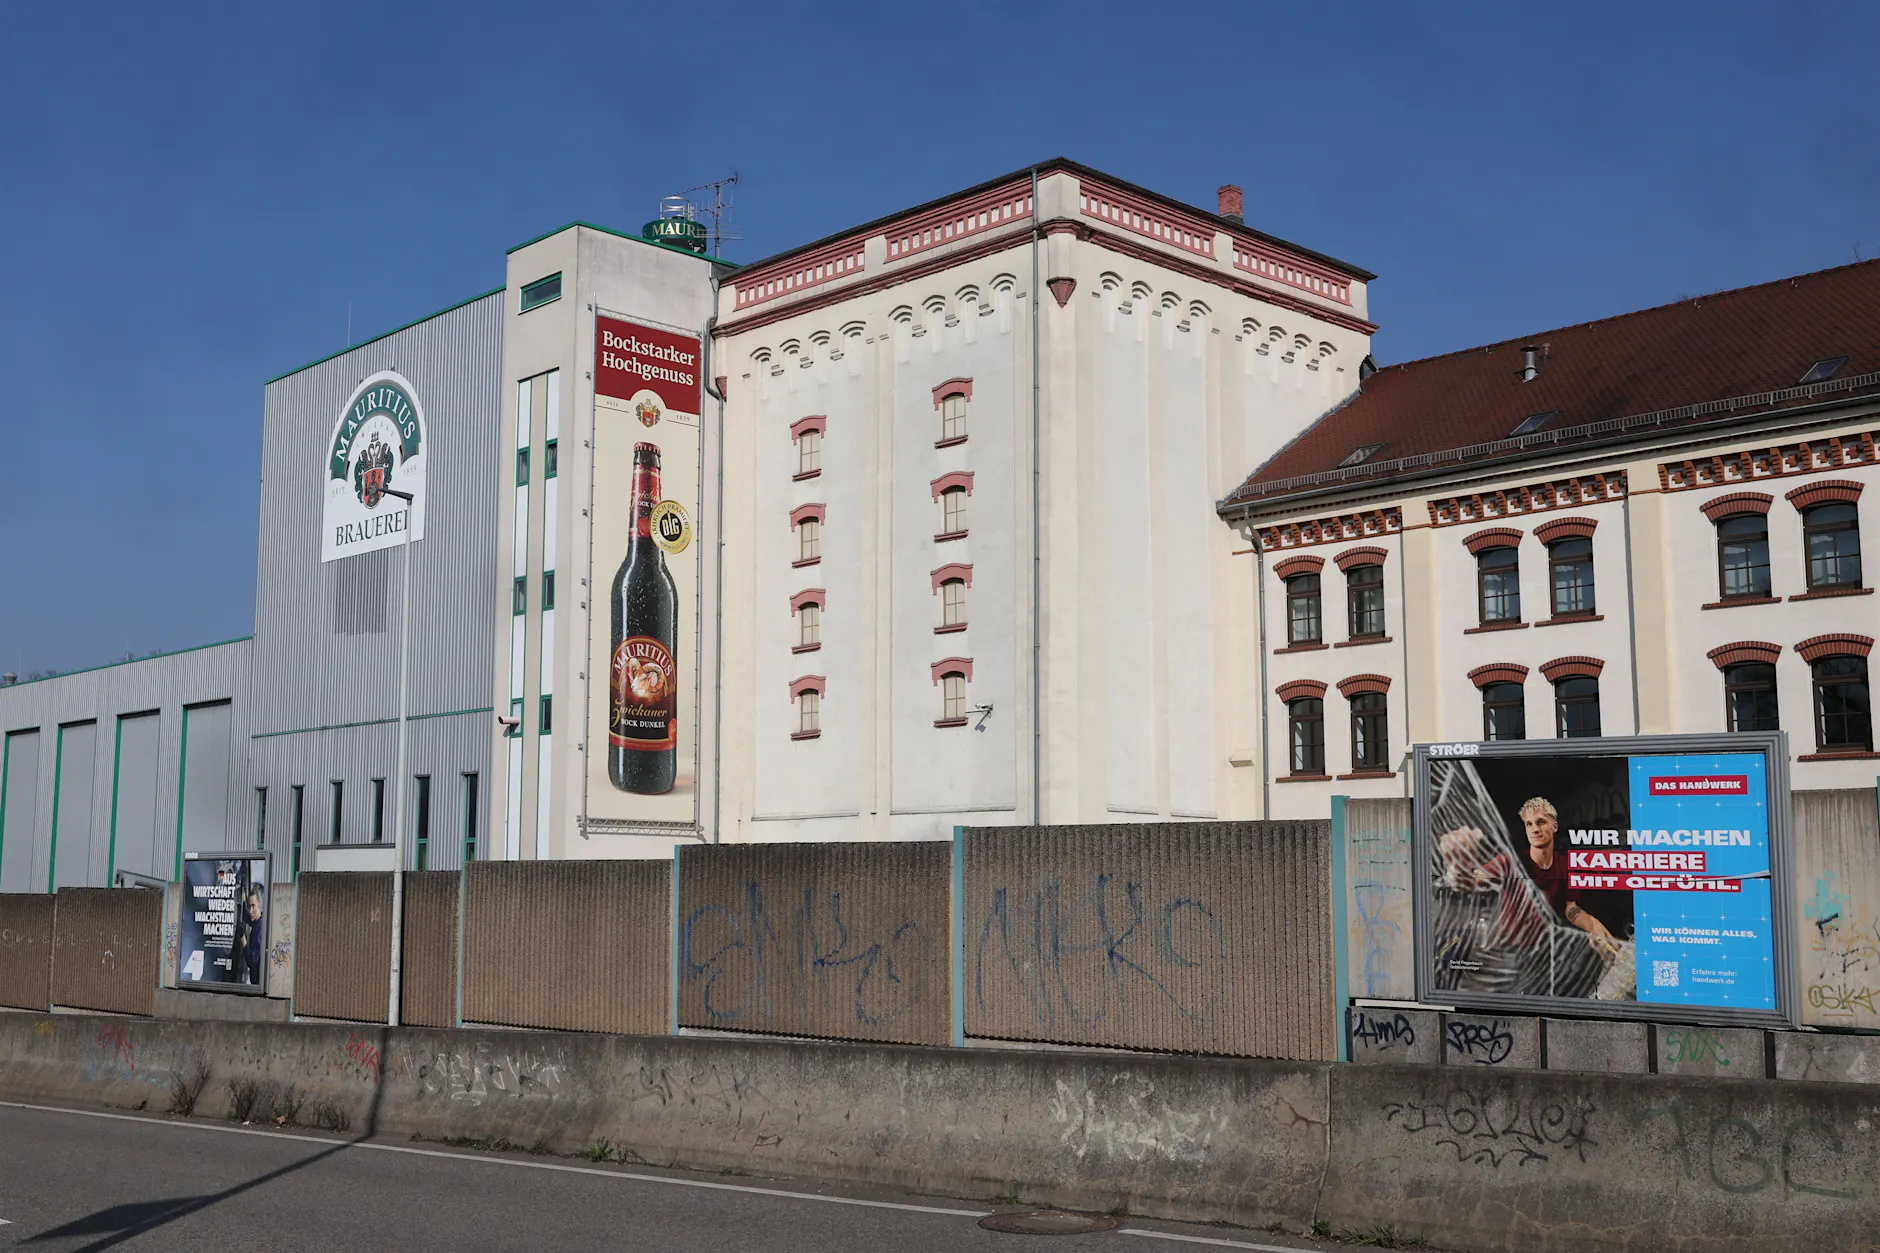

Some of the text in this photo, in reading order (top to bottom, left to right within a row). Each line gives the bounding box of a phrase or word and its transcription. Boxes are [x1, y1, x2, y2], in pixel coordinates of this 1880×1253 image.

[602, 330, 695, 366] Bockstarker
[602, 351, 694, 386] Hochgenuss
[676, 414, 690, 422] 1859
[335, 388, 416, 463] MAURITIUS
[335, 509, 408, 547] BRAUEREI
[661, 510, 680, 537] DLG
[613, 643, 673, 677] MAURITIUS
[611, 699, 668, 727] Zwickauer
[621, 718, 665, 728] BOCK DUNKEL
[1429, 743, 1479, 756] STRÖER
[1655, 779, 1741, 790] DAS HANDWERK
[1568, 829, 1751, 846] WIR MACHEN
[1569, 852, 1704, 870] KARRIERE
[222, 872, 236, 885] AUS
[1570, 875, 1618, 888] MIT
[193, 885, 236, 898] WIRTSCHAFT
[208, 899, 235, 911] WIEDER
[194, 911, 234, 923] WACHSTUM
[203, 923, 234, 936] MACHEN
[1651, 927, 1757, 938] WIR KÖNNEN ALLES,
[1679, 936, 1722, 945] KOMMT.
[1692, 976, 1735, 985] handwerk.de
